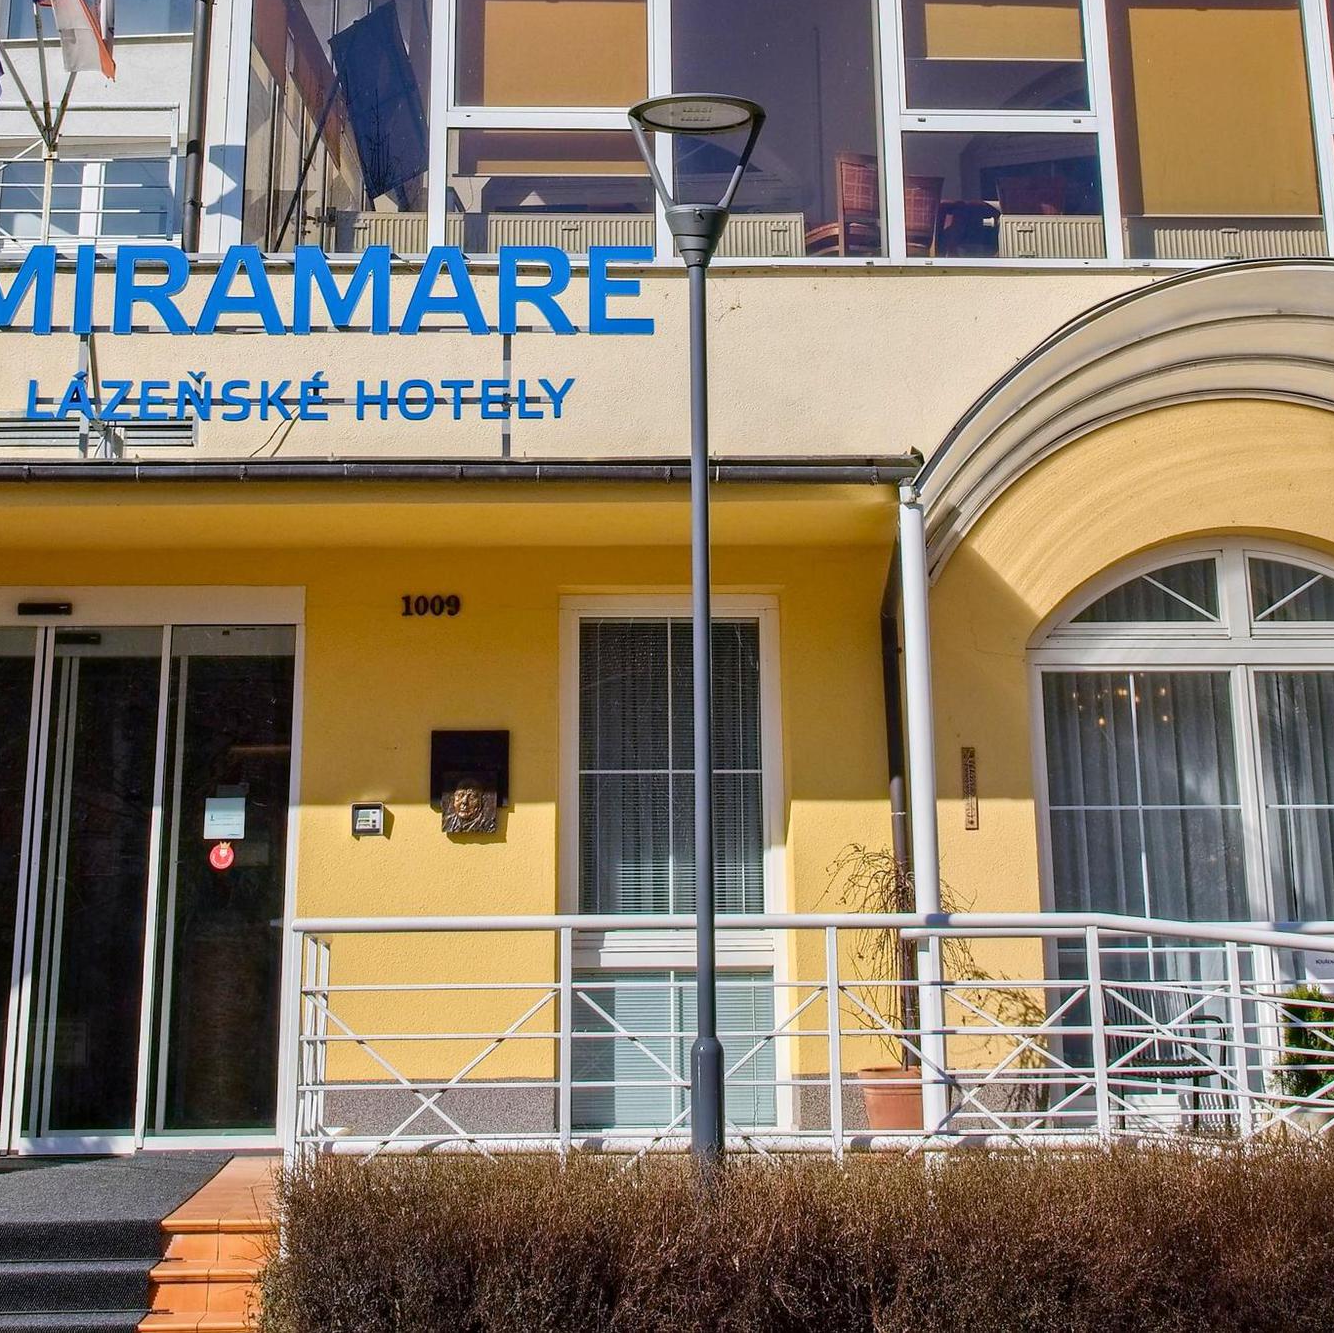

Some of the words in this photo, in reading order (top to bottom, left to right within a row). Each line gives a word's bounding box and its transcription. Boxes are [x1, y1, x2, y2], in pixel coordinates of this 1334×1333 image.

[26, 371, 329, 421] LÁZEŇSKÉ
[356, 378, 575, 420] HOTELY
[401, 595, 461, 616] 1009
